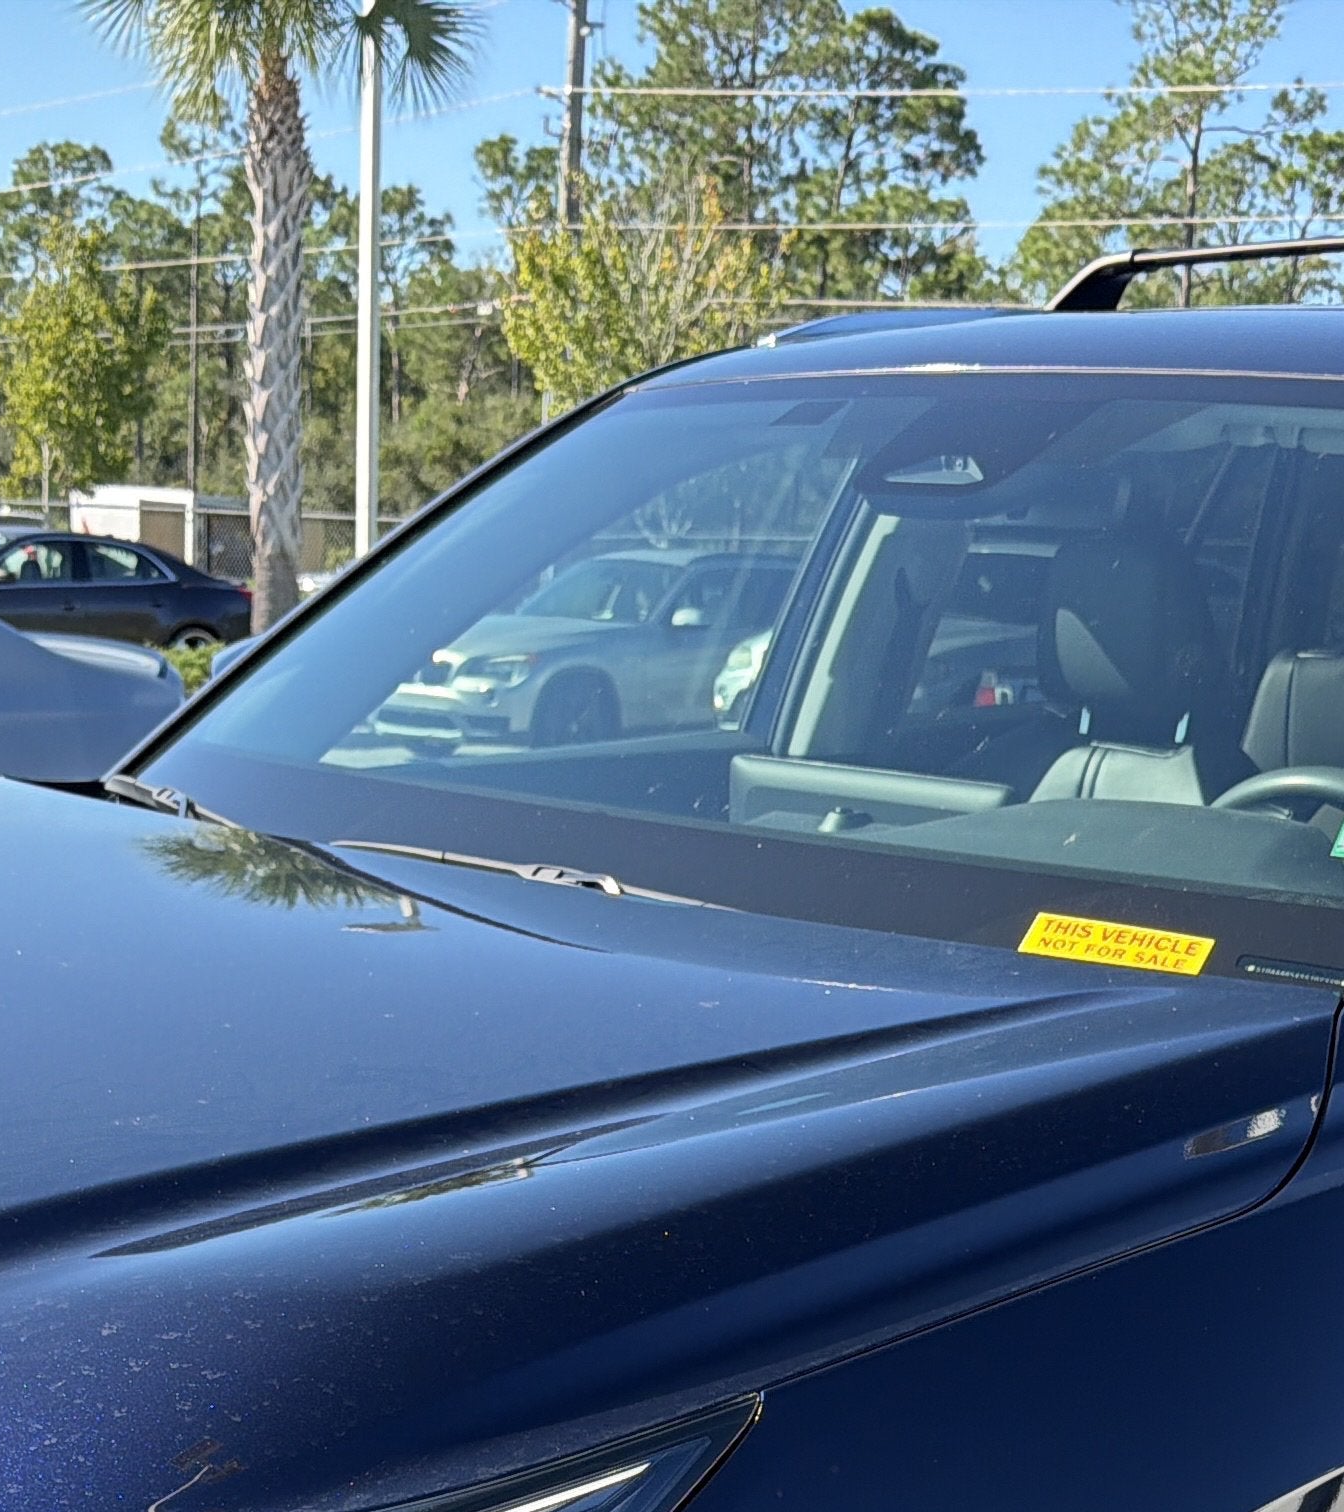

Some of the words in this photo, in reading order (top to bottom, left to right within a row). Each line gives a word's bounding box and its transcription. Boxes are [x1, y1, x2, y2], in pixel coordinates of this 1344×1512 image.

[1038, 937, 1080, 952] NOT
[1084, 943, 1127, 960] FOR
[1133, 951, 1188, 969] SALE
[1043, 919, 1094, 939] THIS
[1101, 927, 1202, 957] VEHICLE
